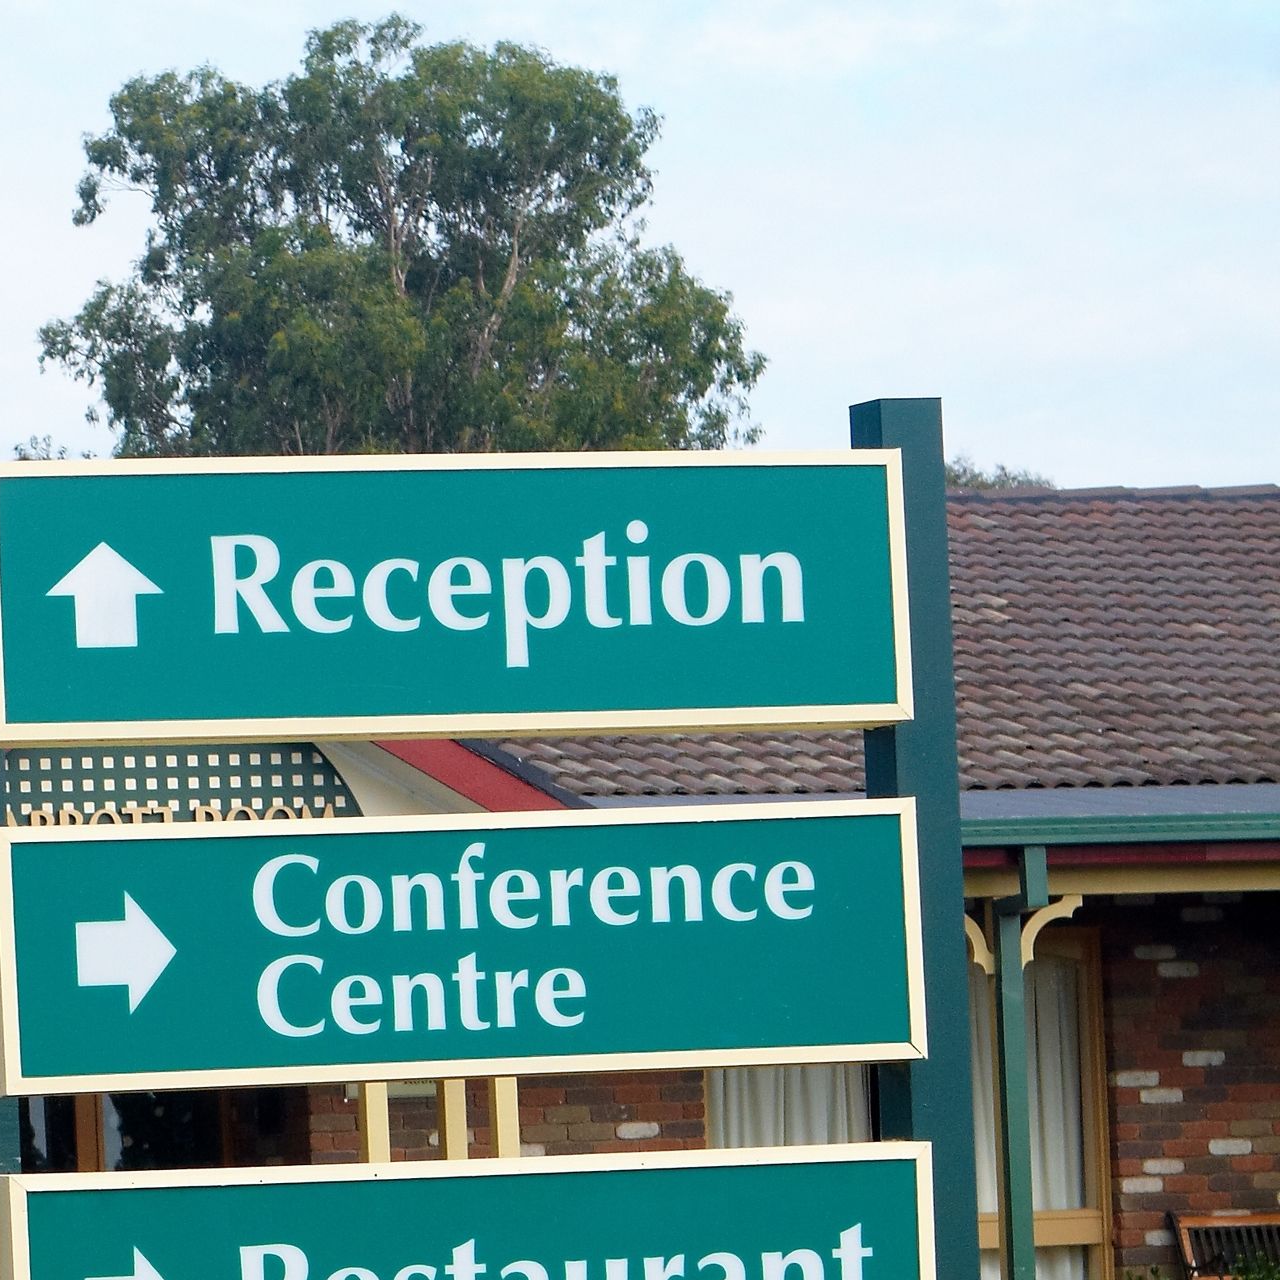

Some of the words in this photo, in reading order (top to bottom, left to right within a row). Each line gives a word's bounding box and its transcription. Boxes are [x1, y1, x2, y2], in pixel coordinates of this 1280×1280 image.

[211, 520, 804, 668] Reception
[252, 843, 815, 937] Conference
[258, 953, 587, 1038] Centre
